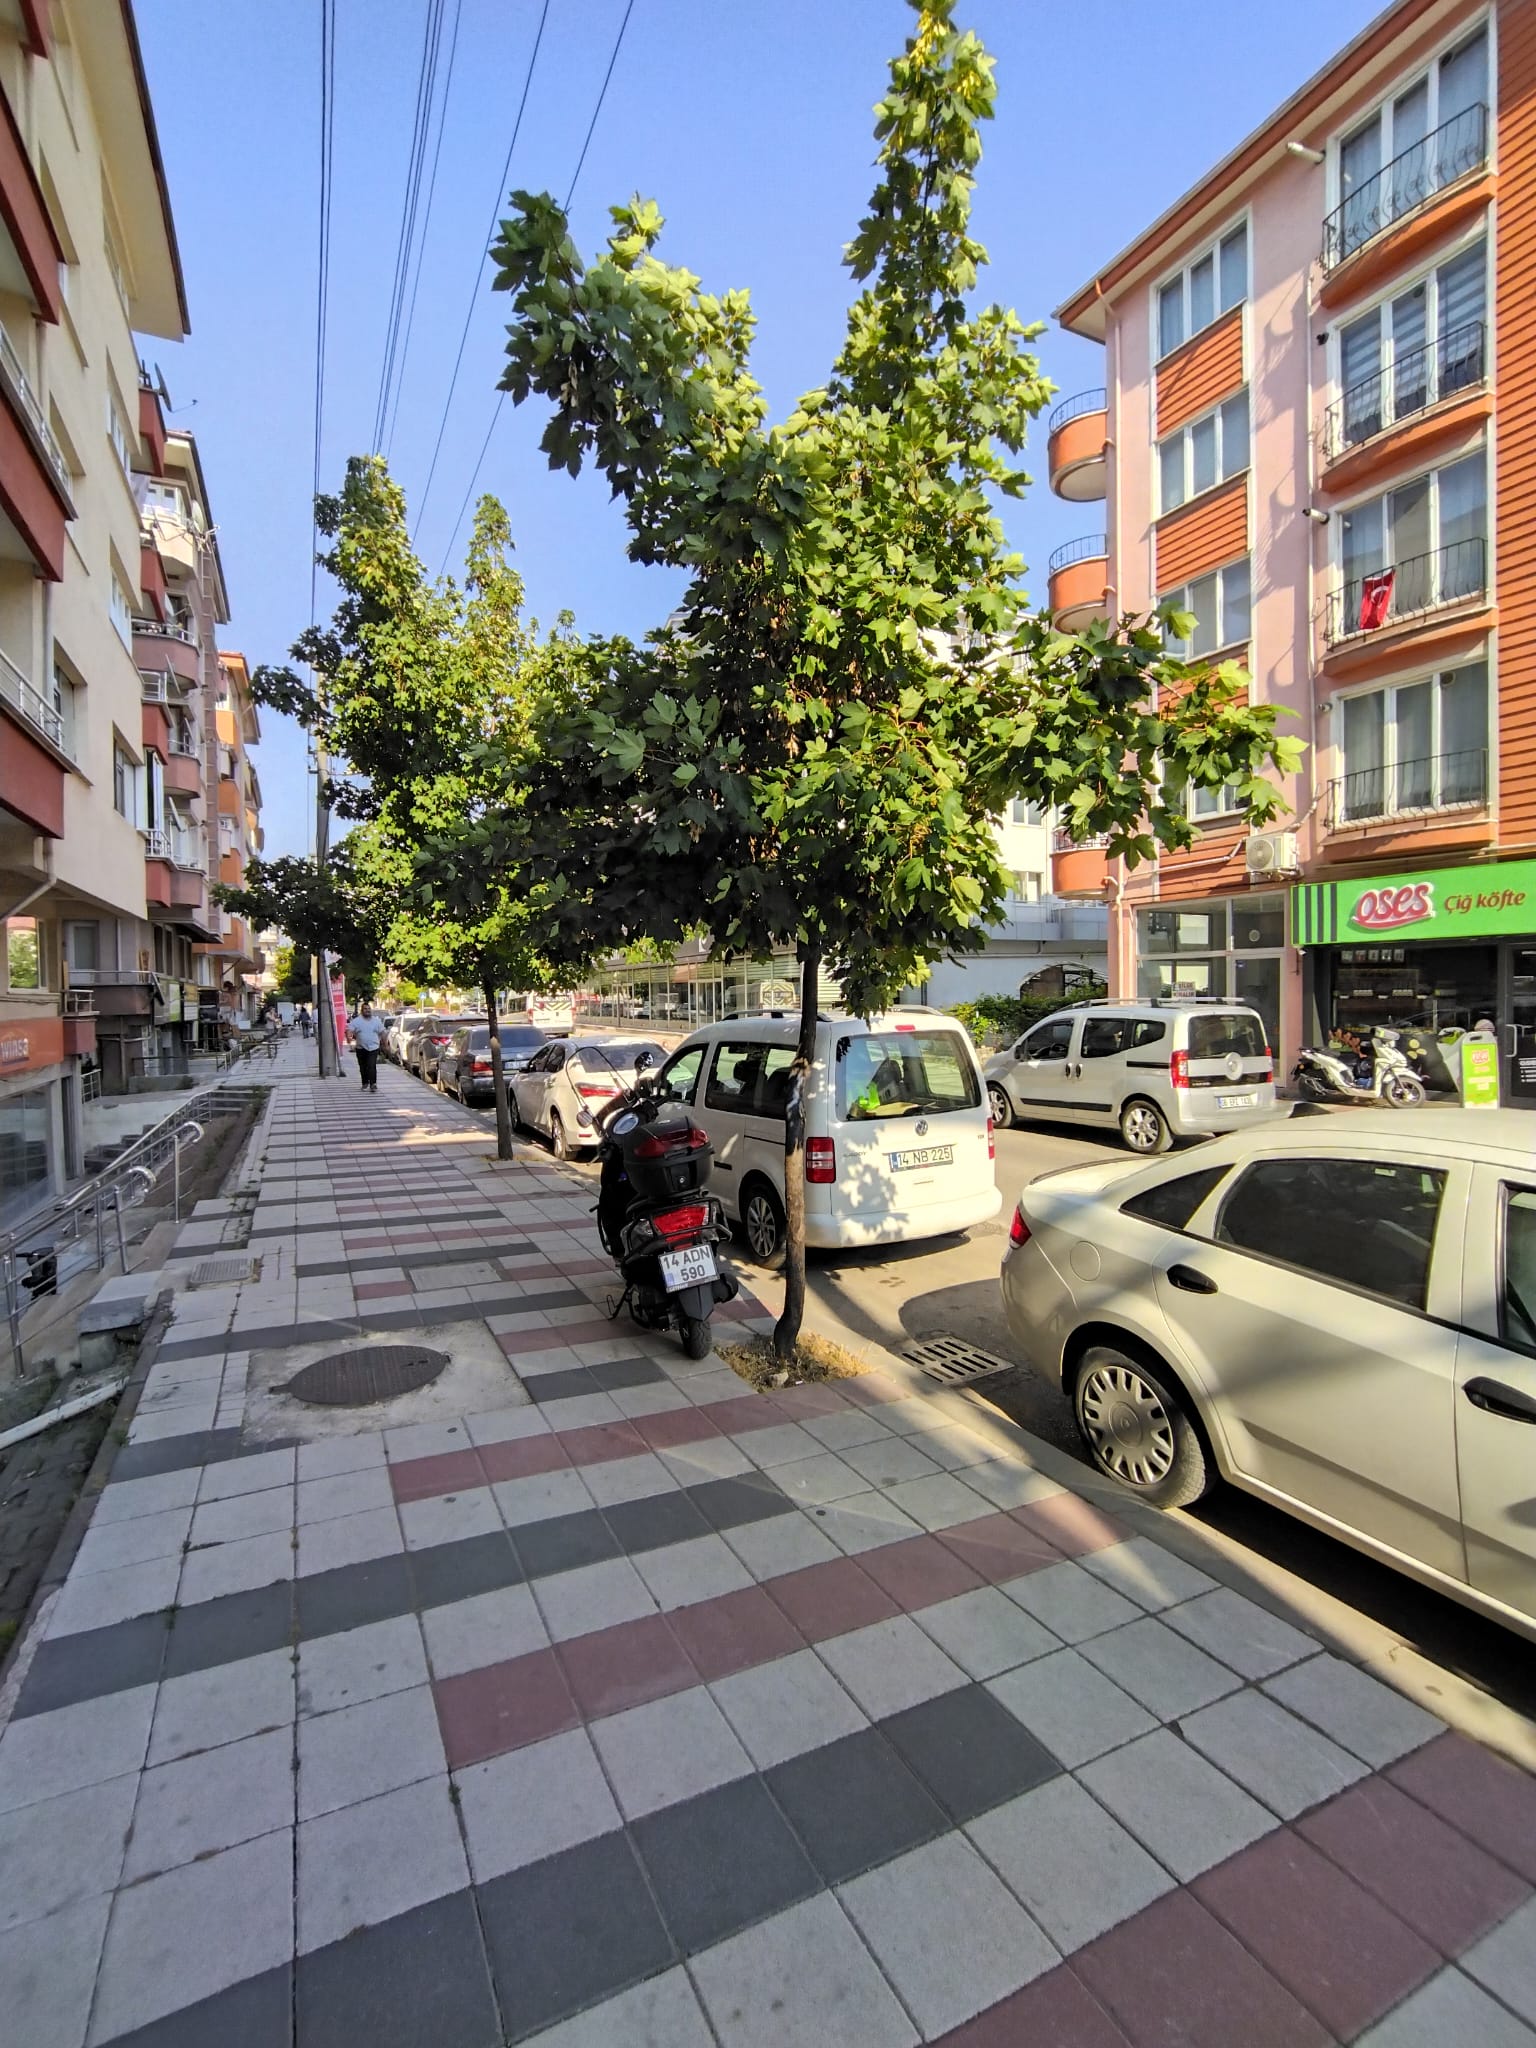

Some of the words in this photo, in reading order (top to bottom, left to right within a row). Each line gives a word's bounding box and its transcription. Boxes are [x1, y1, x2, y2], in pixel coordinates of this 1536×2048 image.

[1444, 894, 1472, 915] Çiğ
[1476, 889, 1526, 912] köfte
[898, 1153, 908, 1165] 14
[913, 1150, 929, 1163] NB
[931, 1147, 950, 1161] 225
[663, 1255, 680, 1269] 14
[683, 1246, 710, 1265] ADN
[680, 1264, 706, 1281] 590
